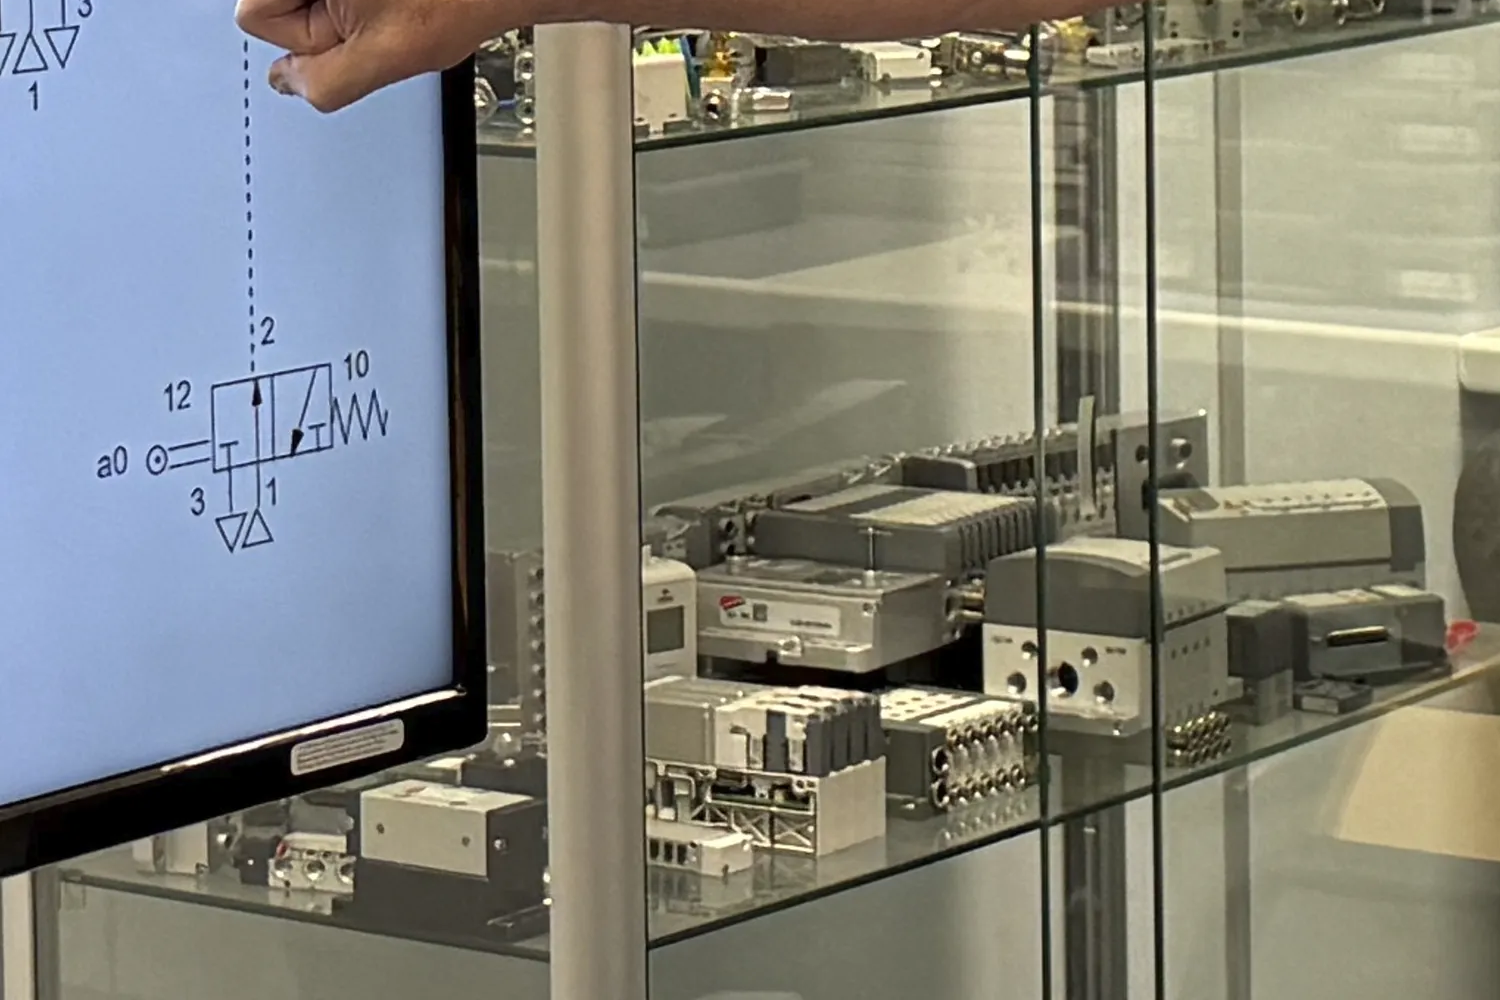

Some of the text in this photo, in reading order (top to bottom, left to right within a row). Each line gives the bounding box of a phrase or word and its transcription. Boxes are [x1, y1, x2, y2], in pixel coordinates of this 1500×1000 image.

[27, 80, 38, 111] 1
[260, 316, 275, 346] 2
[343, 350, 370, 381] 10
[163, 380, 192, 412] 12
[96, 445, 128, 479] a0
[190, 486, 206, 517] 3
[265, 476, 277, 507] 1
